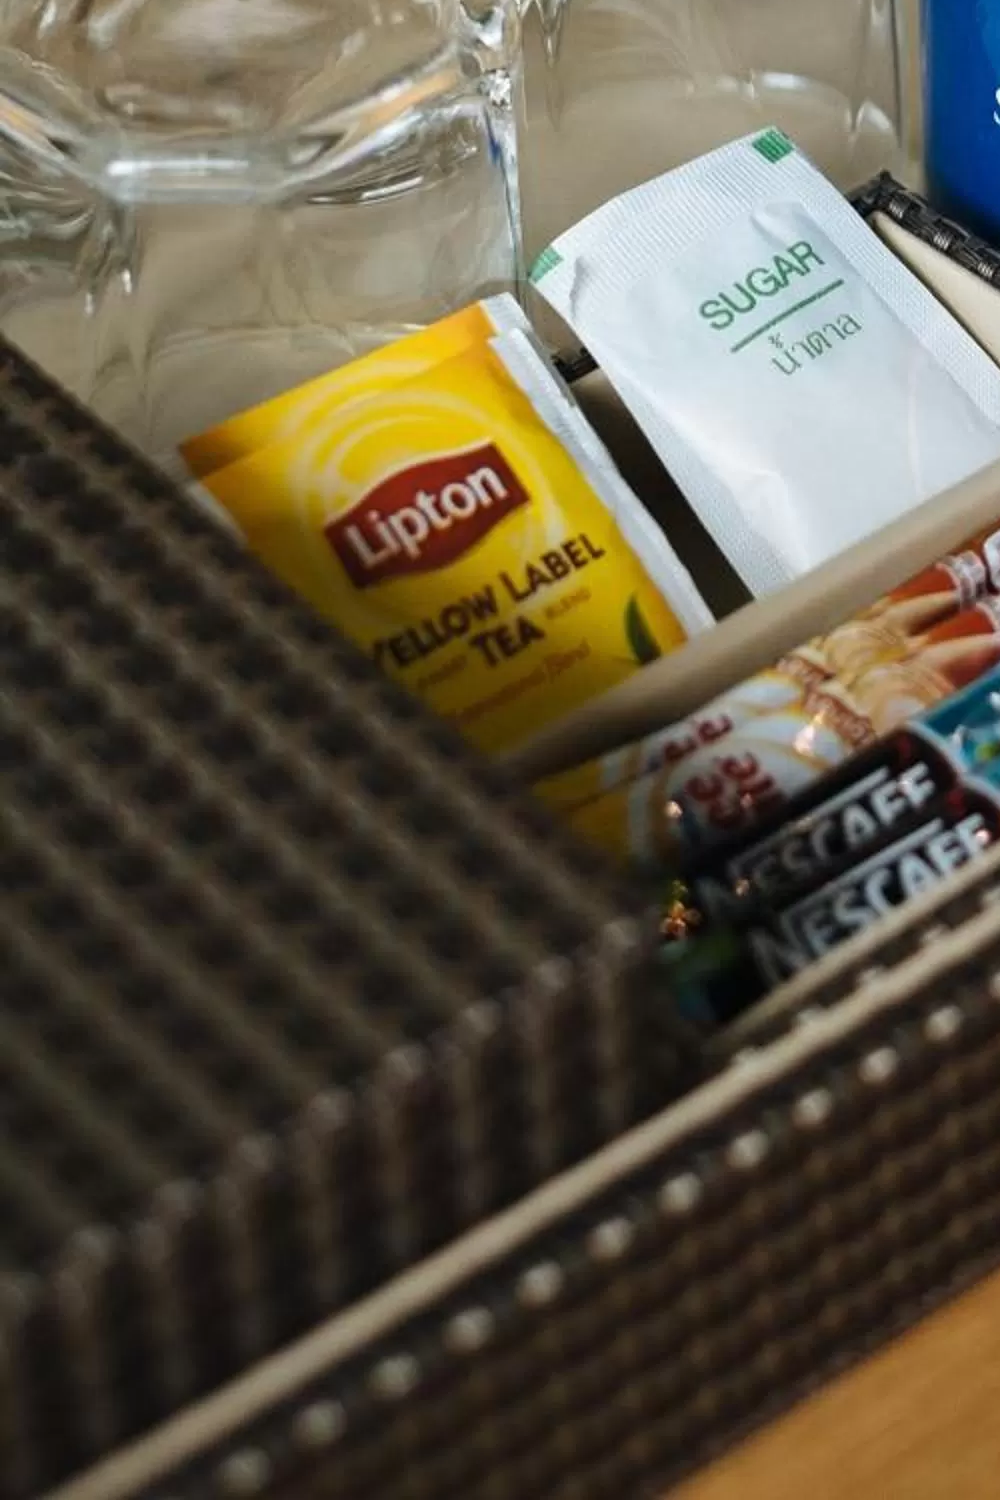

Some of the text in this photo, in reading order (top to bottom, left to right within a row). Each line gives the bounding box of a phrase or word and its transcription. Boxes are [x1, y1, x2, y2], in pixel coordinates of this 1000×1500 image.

[699, 239, 826, 332] SUGAR
[767, 312, 862, 376] น้ำตาล
[345, 466, 509, 569] Lipton
[499, 532, 606, 603] LABEL
[468, 614, 546, 669] TEA
